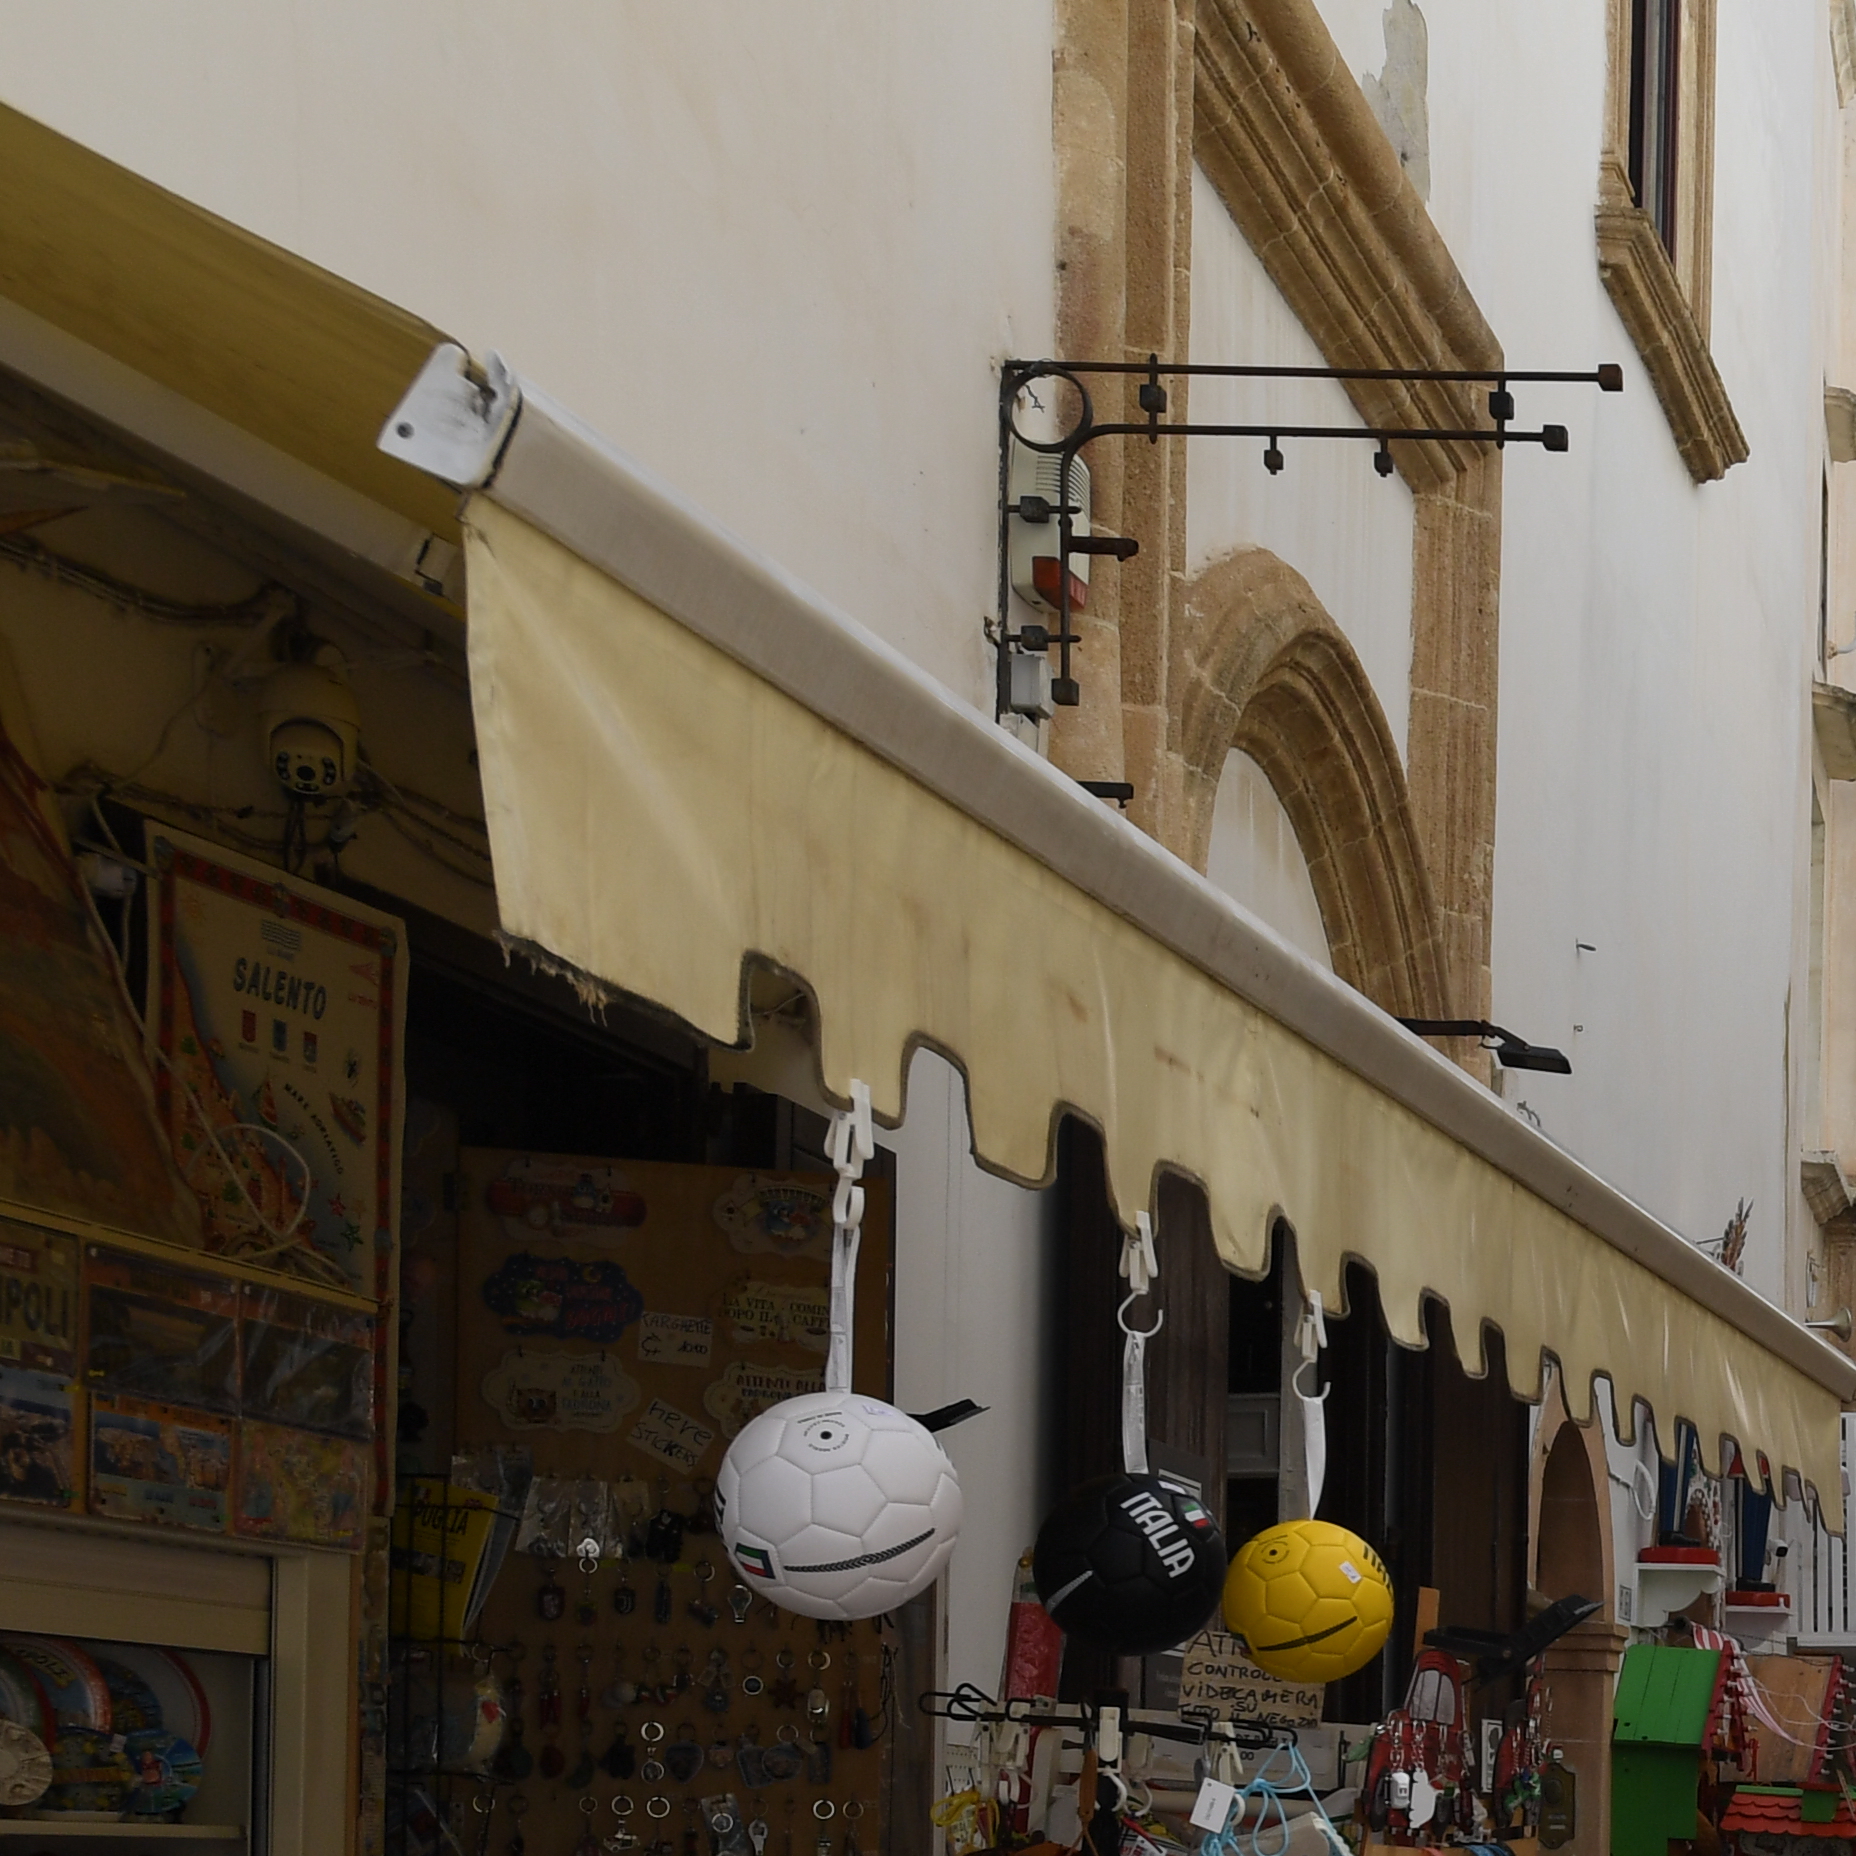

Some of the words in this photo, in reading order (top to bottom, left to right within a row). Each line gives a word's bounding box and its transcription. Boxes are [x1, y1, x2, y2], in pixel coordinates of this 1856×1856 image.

[232, 957, 327, 1021] SALENTO
[746, 1297, 775, 1310] VITA
[790, 1302, 829, 1316] COMIN
[631, 1422, 698, 1468] STICKERS
[649, 1401, 713, 1446] here
[1119, 1491, 1197, 1580] ITALIA
